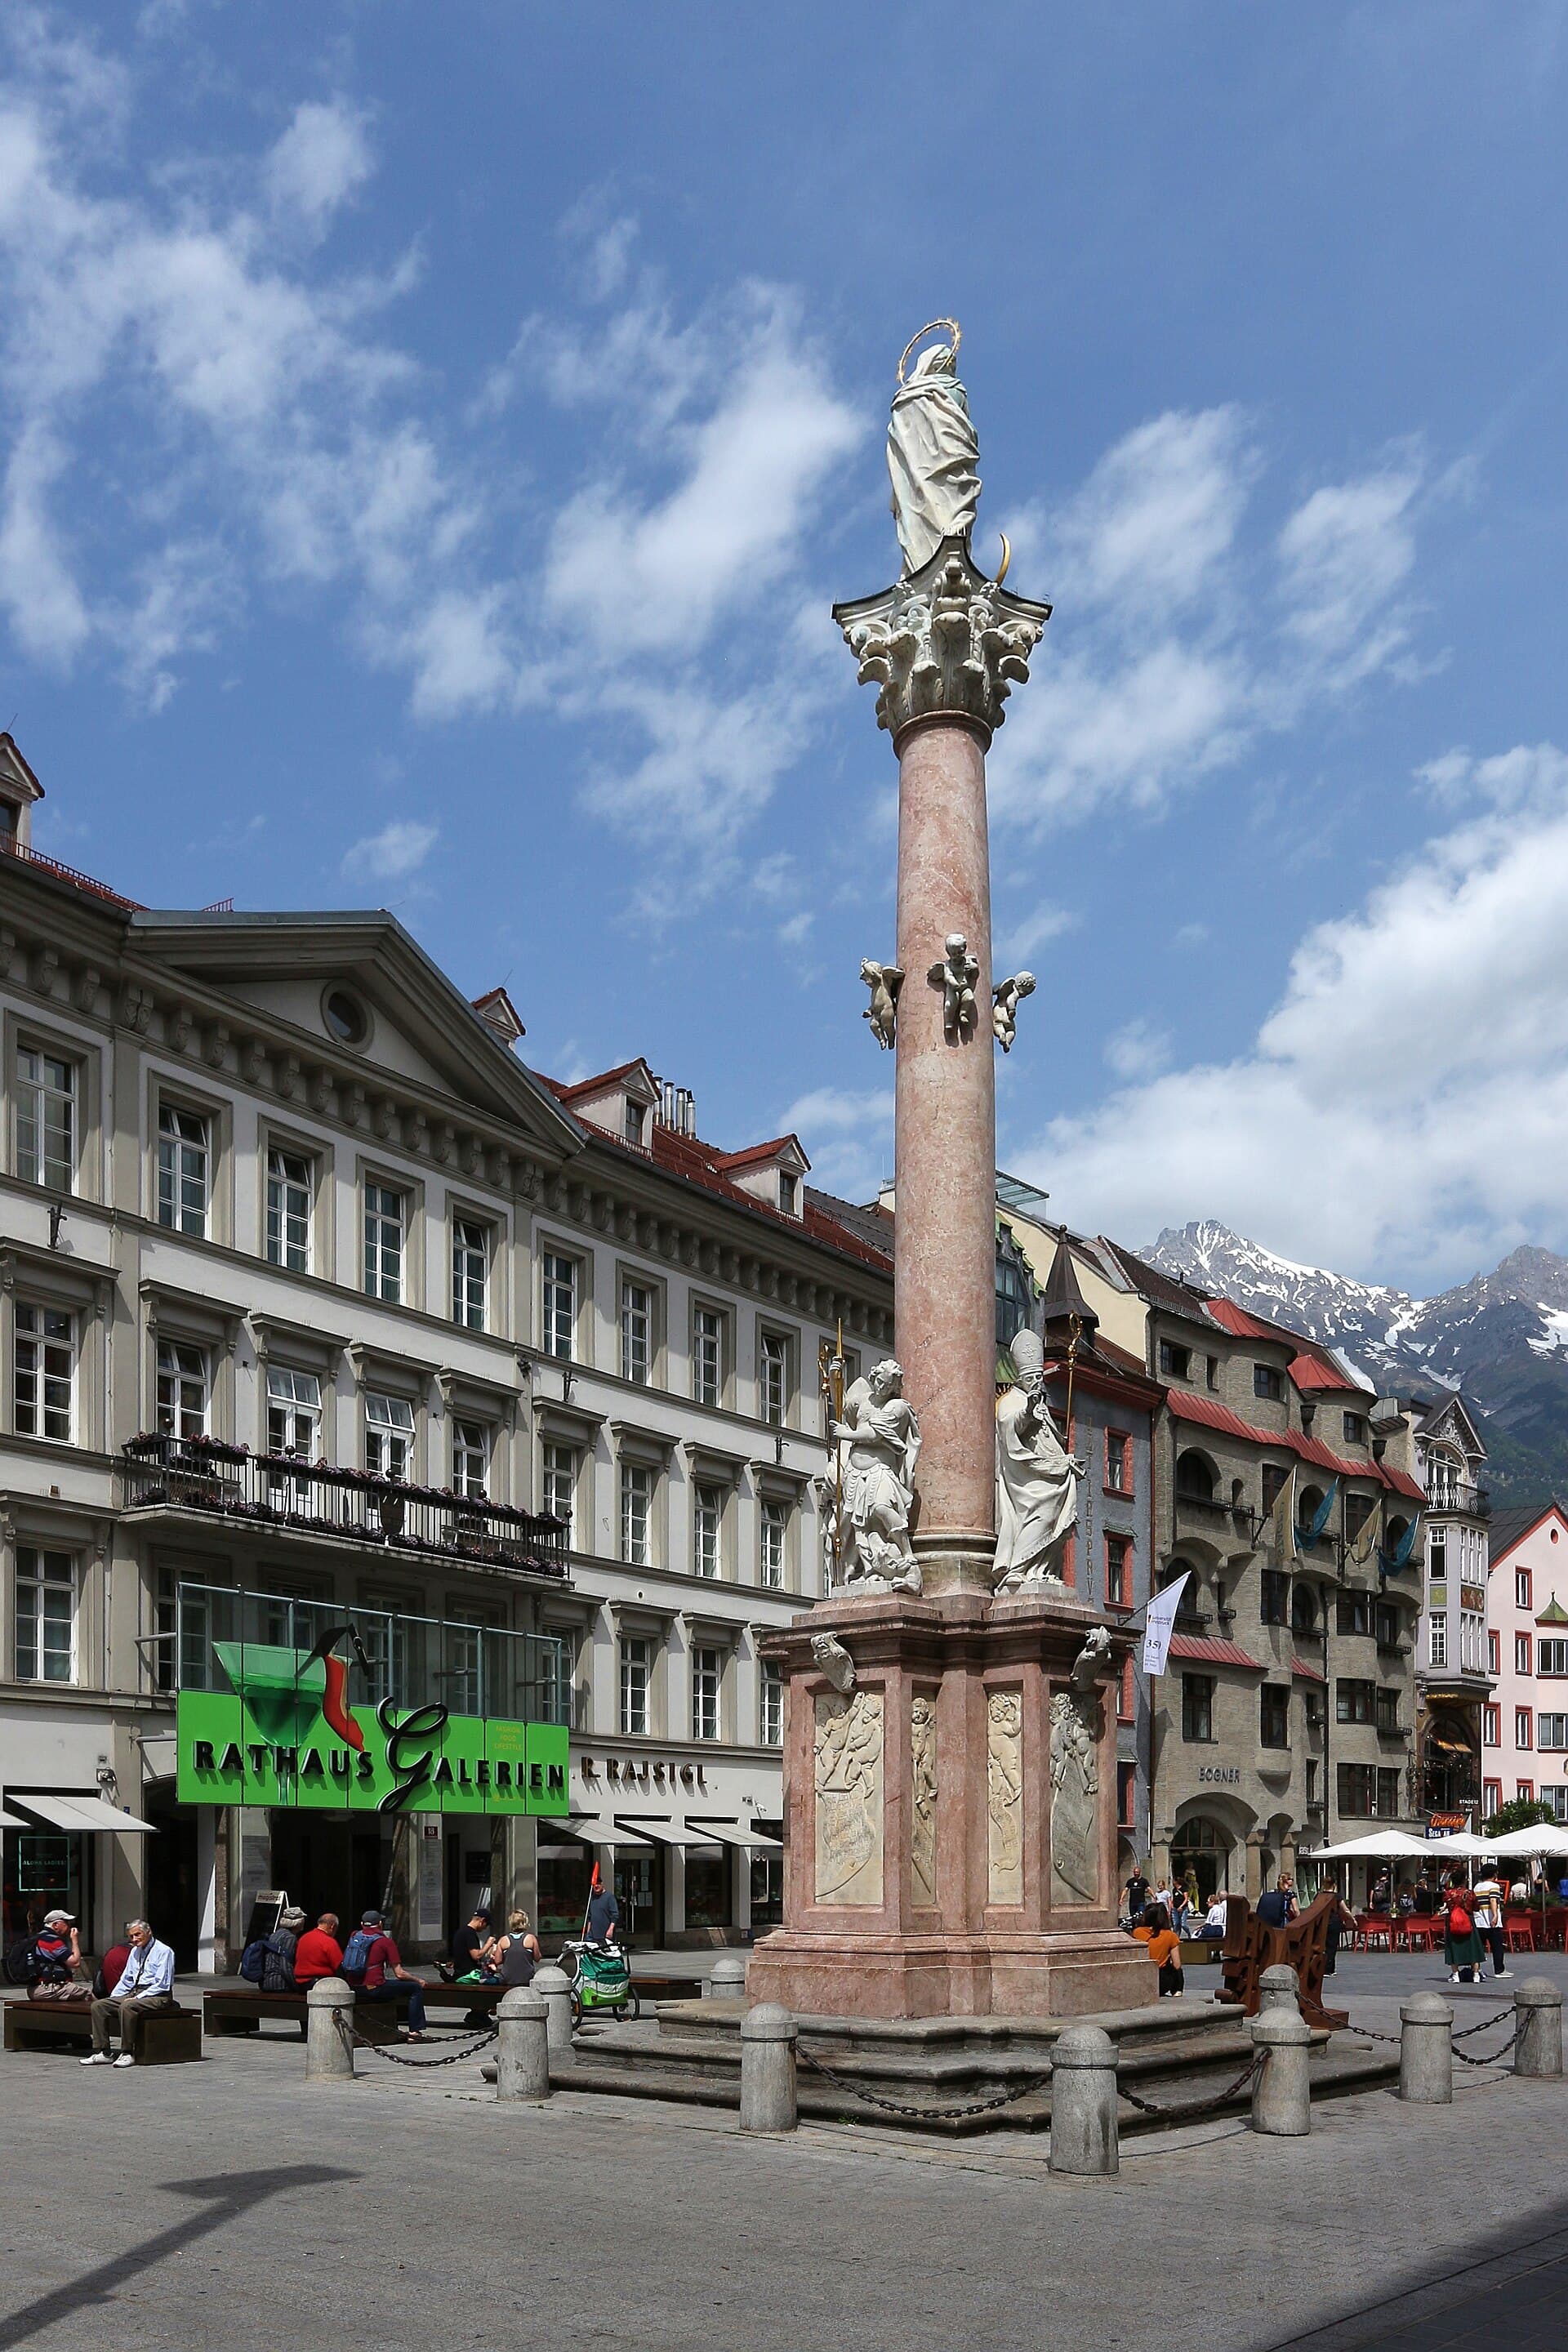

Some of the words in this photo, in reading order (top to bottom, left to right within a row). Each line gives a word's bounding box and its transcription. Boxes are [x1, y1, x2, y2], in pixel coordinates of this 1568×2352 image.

[193, 1740, 375, 1778] RATHAUS
[376, 1696, 564, 1815] GALERIEN
[606, 1758, 708, 1784] RAJSIGL
[1198, 1767, 1240, 1783] BOGNER
